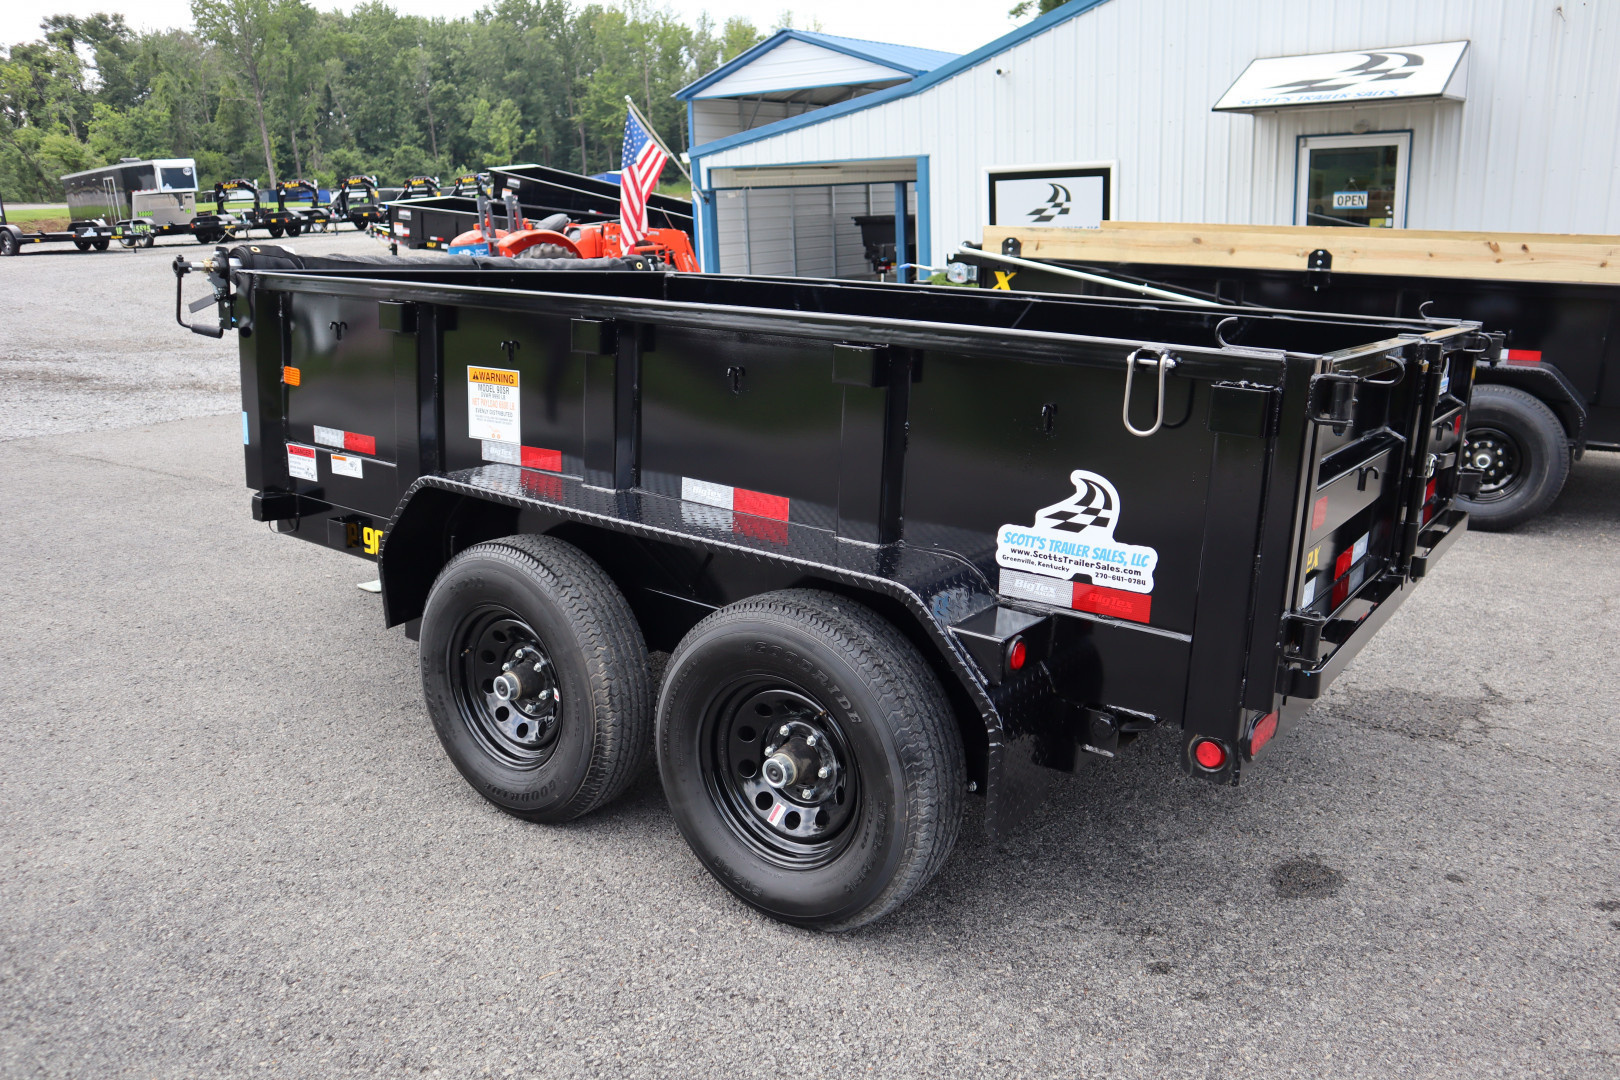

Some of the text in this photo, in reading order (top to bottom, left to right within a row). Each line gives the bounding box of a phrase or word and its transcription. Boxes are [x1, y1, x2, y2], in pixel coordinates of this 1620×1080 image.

[1337, 195, 1365, 206] OPEN
[478, 371, 514, 384] WARNING
[478, 383, 495, 393] MODEL
[1003, 531, 1151, 568] SCOTT'S TRAILER SALES, LLC
[1002, 554, 1070, 573] Greenville, Kentucky
[1010, 547, 1142, 576] www.ScottsTrailerSales.com
[1095, 571, 1146, 586] 270-641-0784
